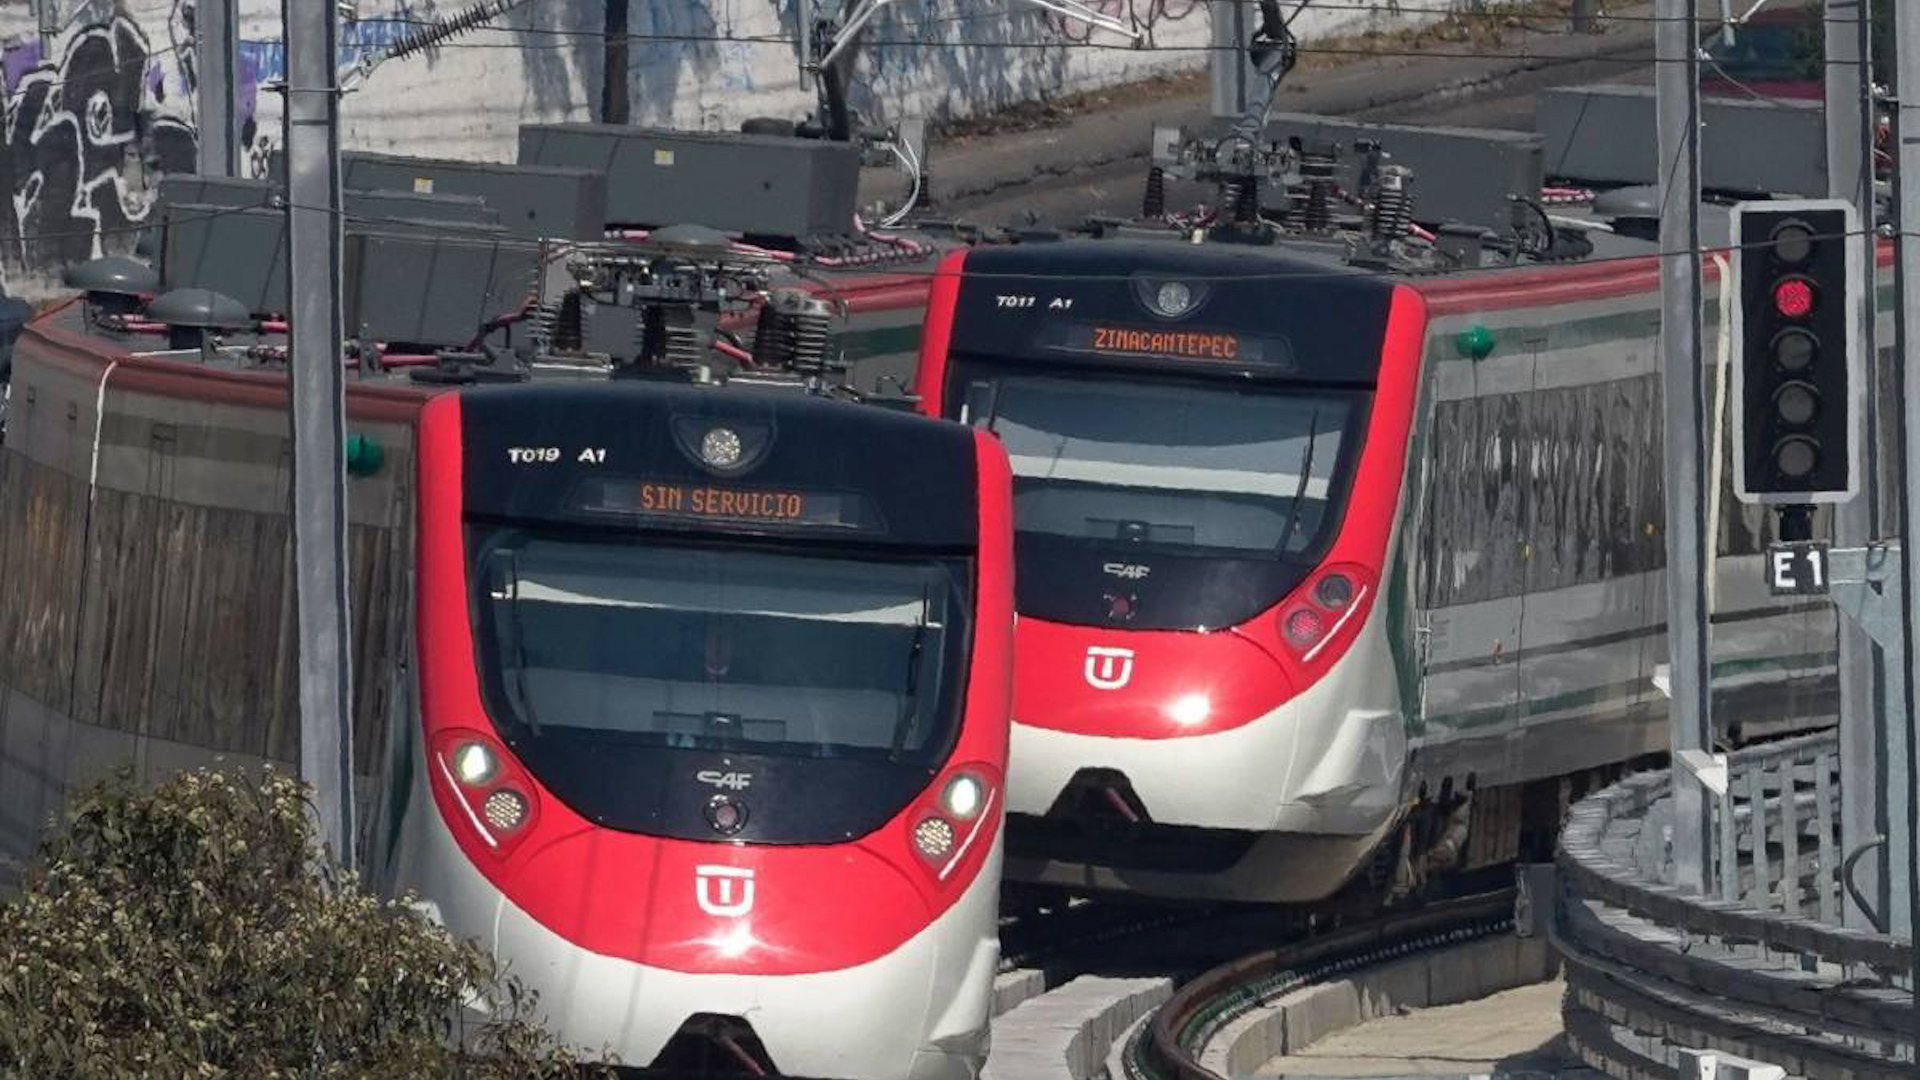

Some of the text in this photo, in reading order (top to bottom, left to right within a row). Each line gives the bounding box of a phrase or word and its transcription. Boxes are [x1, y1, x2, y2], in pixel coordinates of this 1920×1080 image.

[996, 294, 1074, 310] T011 A1
[1093, 327, 1237, 358] ZINACANTEPEC
[507, 447, 606, 464] T019 A1
[641, 483, 801, 518] SIN SERVICIO
[1103, 562, 1151, 580] CAF
[696, 770, 752, 790] CAF
